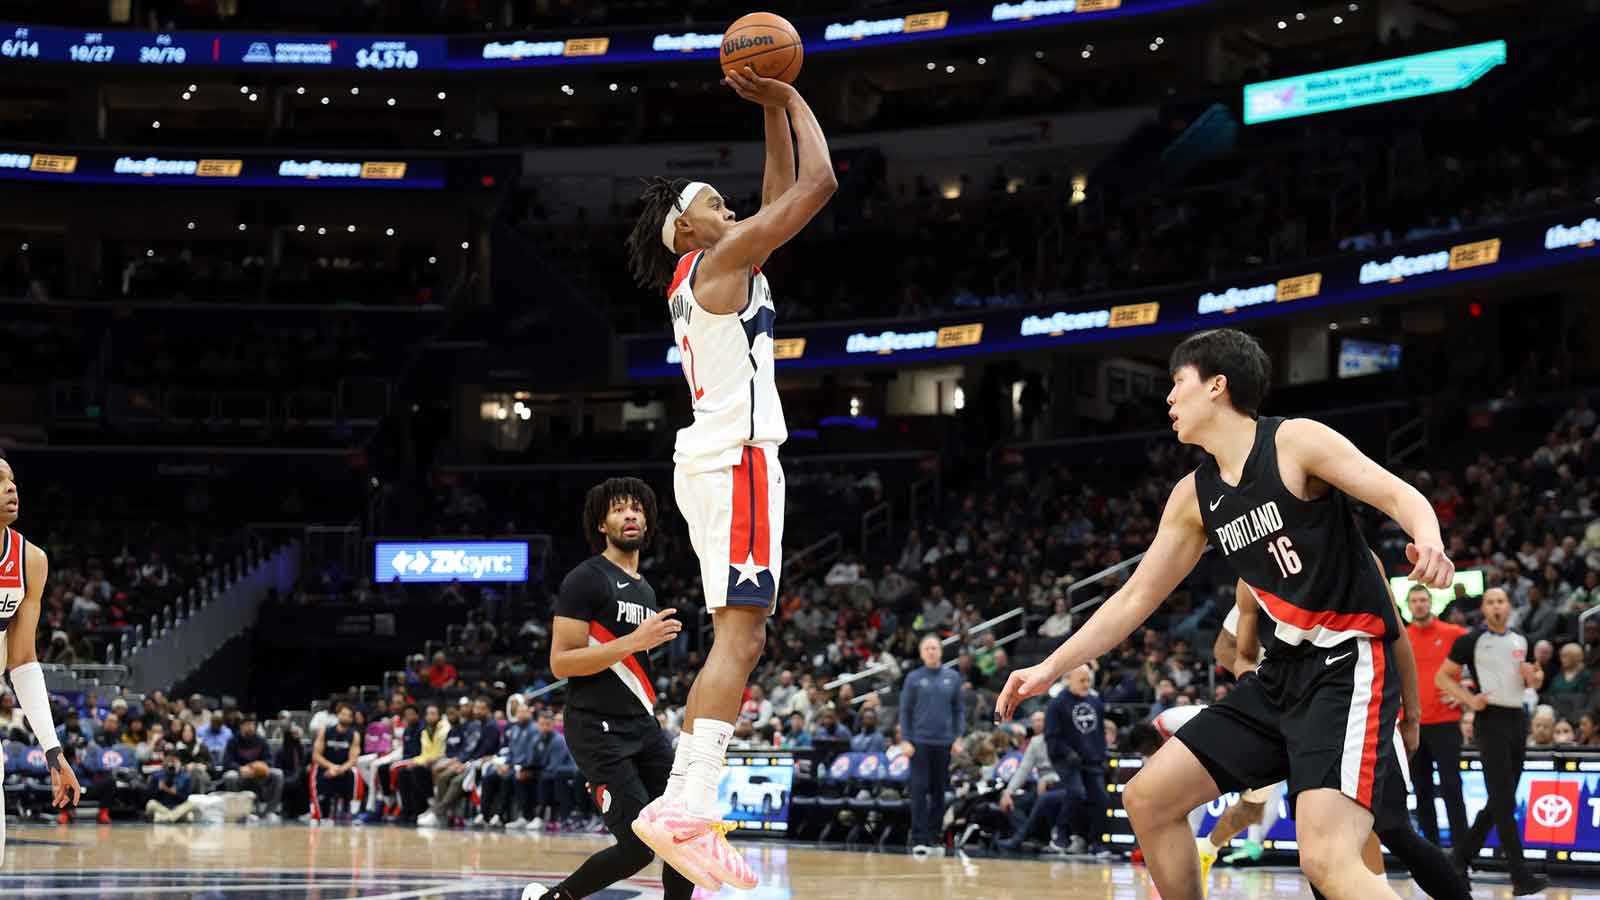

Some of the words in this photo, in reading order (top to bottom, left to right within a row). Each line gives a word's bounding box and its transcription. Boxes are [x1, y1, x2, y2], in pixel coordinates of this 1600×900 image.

[825, 18, 905, 40] theScore
[1, 39, 39, 57] 6/14
[70, 45, 115, 62] 10/27
[483, 41, 565, 58] theScore
[724, 35, 774, 56] Wilson
[355, 48, 418, 70] $4,570
[115, 157, 197, 175] theScore
[279, 160, 362, 177] theScore
[1359, 251, 1449, 284] theScore
[1198, 284, 1277, 313] theScore
[1021, 311, 1110, 335] theScore
[846, 331, 938, 352] theScore
[1215, 501, 1283, 556] PORTLAND
[431, 550, 512, 578] ZKsync
[1268, 536, 1302, 578] 16
